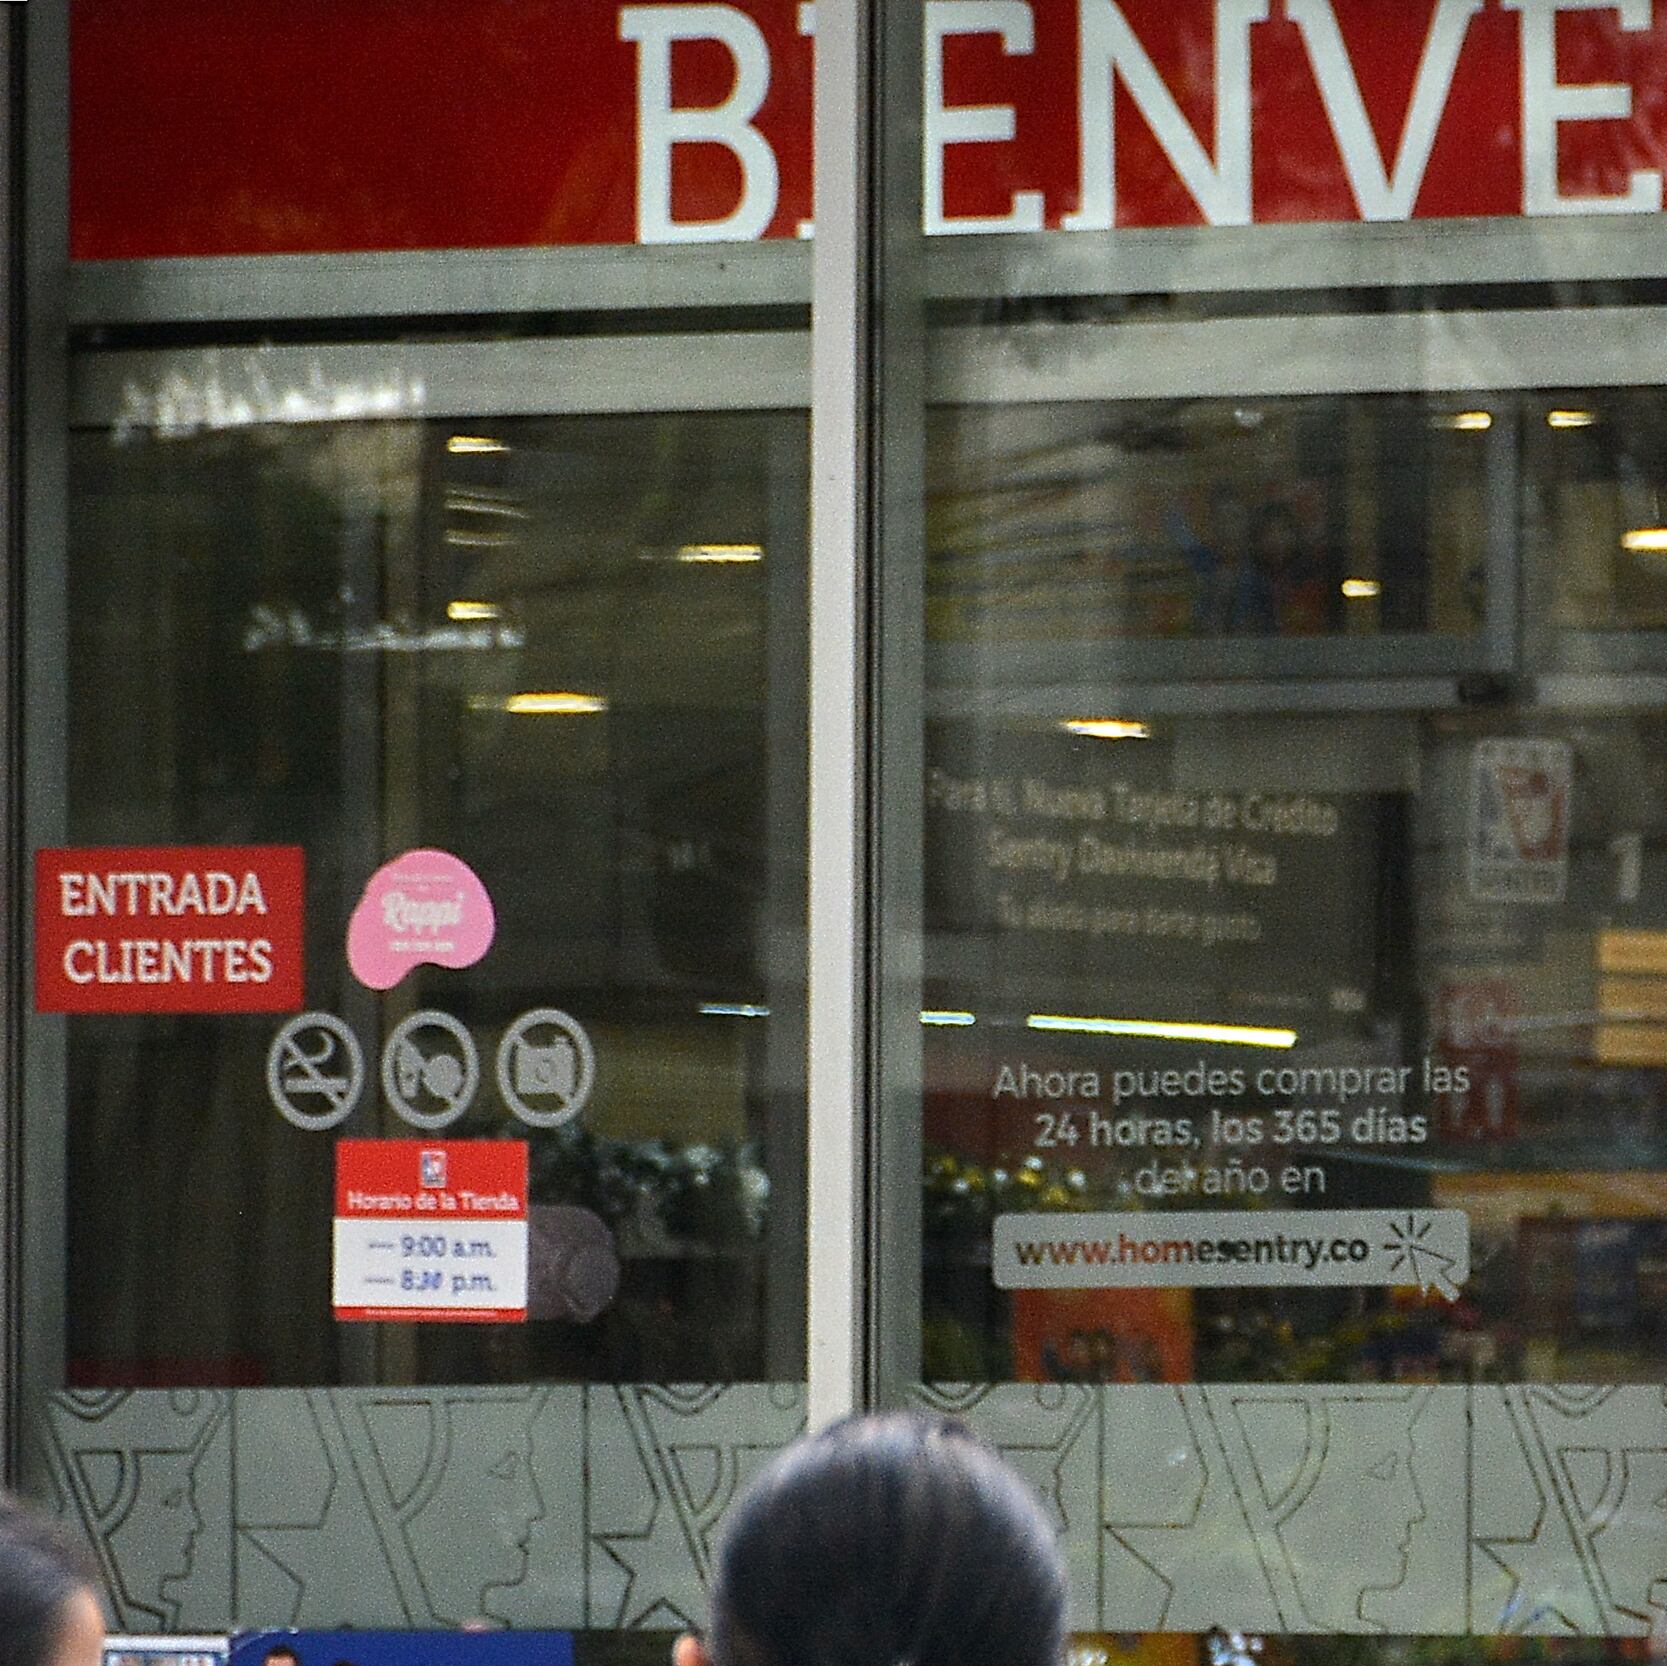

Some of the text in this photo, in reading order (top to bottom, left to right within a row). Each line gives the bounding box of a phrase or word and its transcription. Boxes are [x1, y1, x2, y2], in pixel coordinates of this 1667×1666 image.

[59, 872, 267, 917] ENTRADA
[63, 939, 274, 984] CLIENTES
[993, 1058, 1471, 1106] Ahora puedes comprar las
[1034, 1105, 1428, 1151] 24 horas, los 365 días
[1134, 1159, 1327, 1196] del año en
[348, 1190, 521, 1212] Horario de la Tienda
[401, 1236, 497, 1258] 9:00 a.m.
[1015, 1233, 1371, 1271] www.homesentry.co
[452, 1275, 498, 1297] p.m.
